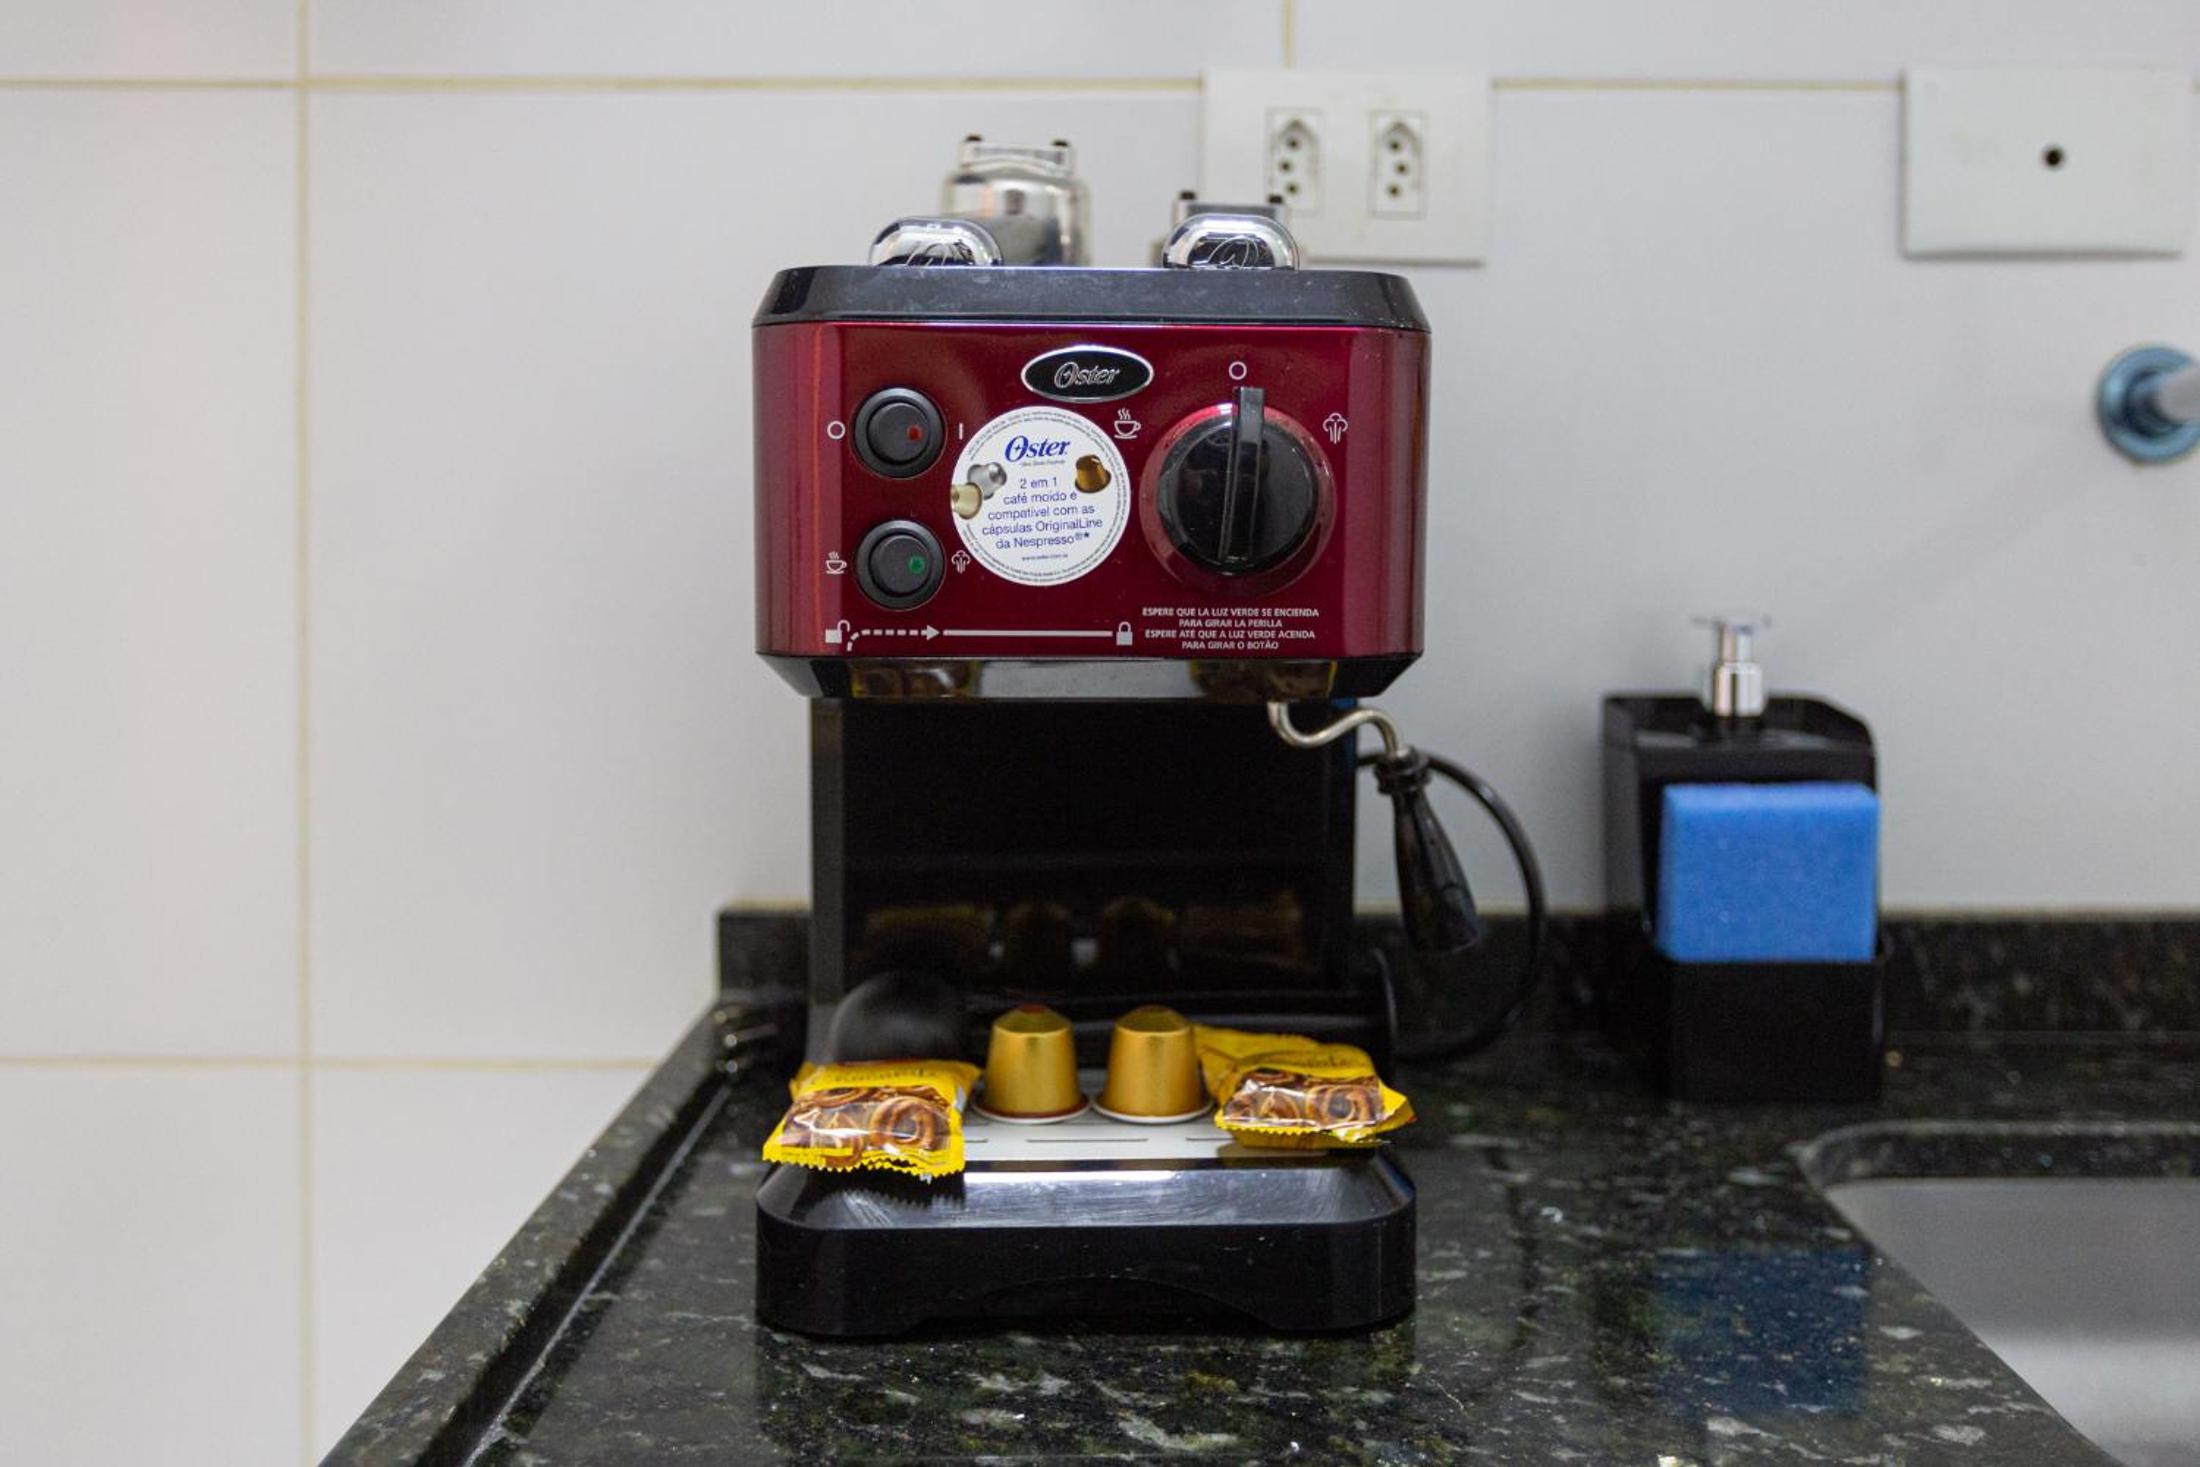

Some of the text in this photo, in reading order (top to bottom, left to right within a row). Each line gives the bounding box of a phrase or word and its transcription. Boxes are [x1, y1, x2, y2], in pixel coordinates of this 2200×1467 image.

[1054, 361, 1120, 388] Oster
[1005, 435, 1071, 462] Oster
[1020, 477, 1058, 489] 2 em 1
[1003, 493, 1028, 505] café
[1070, 492, 1078, 500] e
[1053, 507, 1078, 515] com
[1082, 506, 1095, 514] as
[982, 518, 1103, 536] cápsulas OriginalLine
[995, 539, 1010, 549] da
[1142, 607, 1320, 617] ESPERE QUE LA LUZ VERDE SE ENCIENDA
[1179, 619, 1282, 628] PARA GIRAR LA PERILLA
[1145, 628, 1315, 639] ESPERE ATÉ QUE A LUZ VERDE ACENDA
[1181, 640, 1279, 649] PARA GIRAR O BOTÃO
